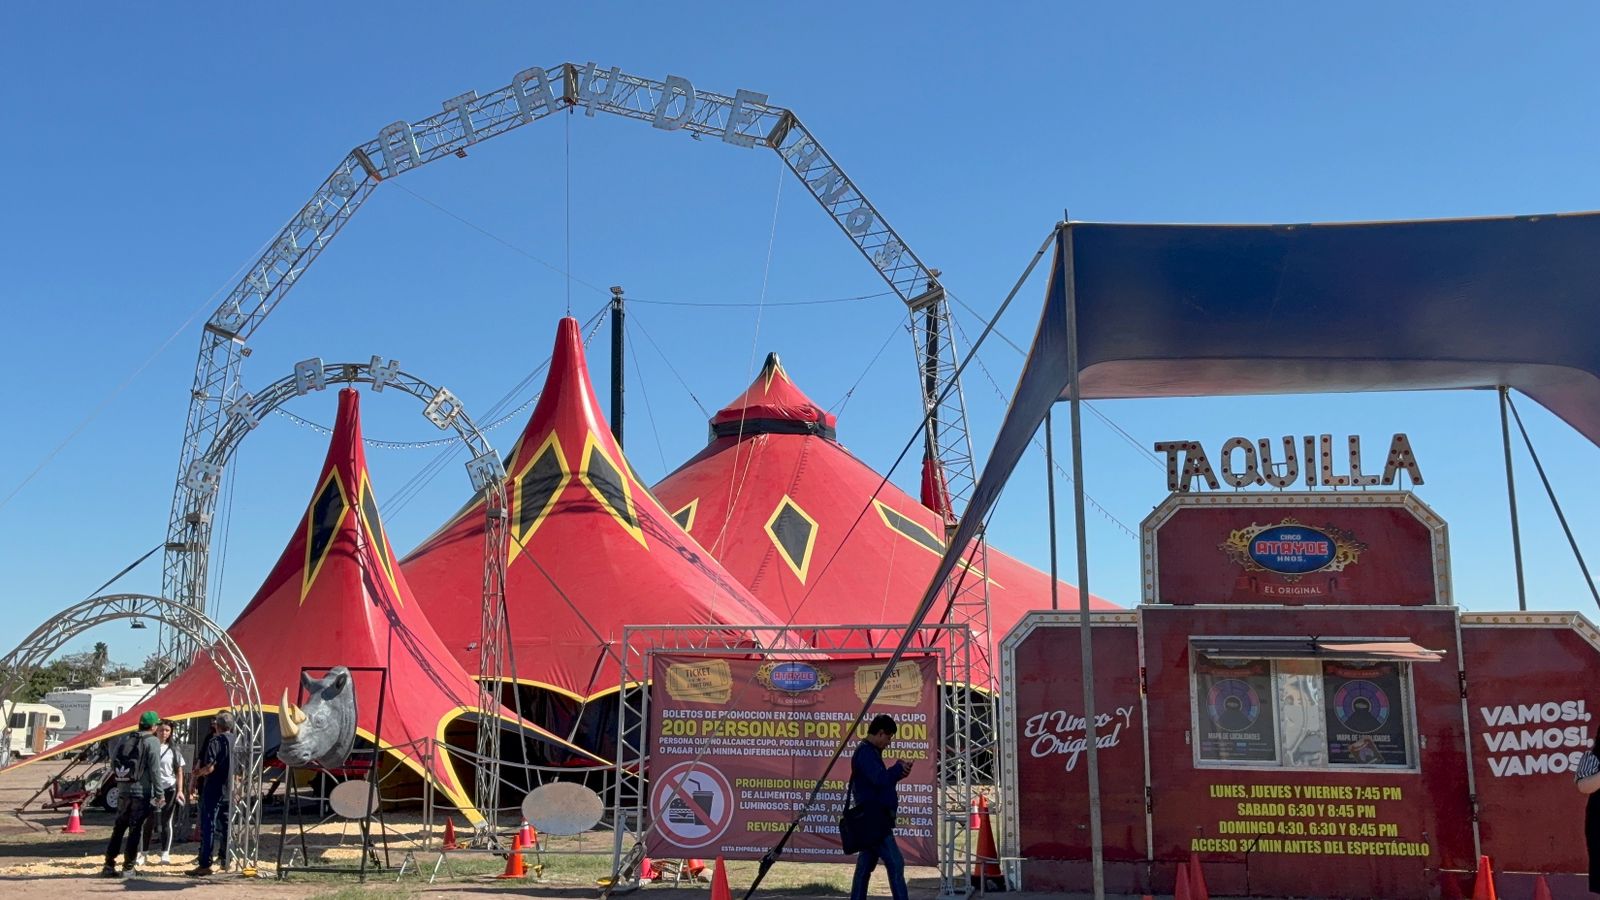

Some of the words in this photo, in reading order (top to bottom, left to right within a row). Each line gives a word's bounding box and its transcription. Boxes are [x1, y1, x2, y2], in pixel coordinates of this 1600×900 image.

[379, 62, 768, 177] ATAYDE
[1154, 433, 1424, 492] TAQUILLA
[1256, 541, 1329, 555] ATAYDE
[1264, 586, 1275, 594] EL
[1278, 586, 1322, 594] ORIGINAL
[662, 710, 703, 719] BOLETOS
[705, 711, 717, 719] DE
[719, 711, 772, 720] PROMOCION
[774, 712, 786, 720] EN
[788, 712, 812, 720] ZONA
[813, 712, 855, 721] GENERAL
[893, 713, 901, 722] A
[901, 713, 927, 722] CUPO
[1024, 712, 1049, 738] El
[1116, 706, 1134, 729] Y
[662, 720, 698, 736] 200
[702, 720, 800, 737] PERSONAS
[804, 722, 841, 738] POR
[659, 737, 694, 745] PERSONA
[722, 738, 755, 746] ALCANCE
[805, 740, 834, 748] ENTRAR
[897, 742, 929, 750] FUNCION
[660, 746, 666, 754] O
[667, 747, 693, 755] PAGAR
[712, 748, 742, 756] MINIMA
[743, 748, 790, 757] DIFERENCIA
[791, 749, 812, 757] PARA
[813, 749, 823, 757] LA
[735, 778, 791, 789] PROHIBIDO
[914, 784, 933, 793] TIPO
[1210, 784, 1248, 799] LUNES,
[1250, 785, 1292, 799] JUEVES
[1294, 786, 1302, 799] Y
[1303, 786, 1353, 799] VIERNES
[1355, 787, 1380, 800] 7:45
[1383, 787, 1401, 800] PM
[741, 790, 752, 799] DE
[753, 791, 804, 800] ALIMENTOS,
[805, 791, 841, 801] BBIDAS
[896, 806, 933, 815] OCHILAS
[1237, 803, 1285, 817] SABADO
[1288, 803, 1315, 817] 6:30
[1317, 804, 1325, 817] Y
[1327, 804, 1355, 818] 8:45
[1357, 805, 1376, 818] PM
[910, 817, 933, 826] SERA
[803, 825, 814, 833] AL
[1219, 821, 1275, 834] DOMINGO
[1277, 821, 1307, 836] 4:30,
[1309, 822, 1337, 836] 6:30
[1338, 823, 1347, 836] Y
[1349, 823, 1376, 837] 8:45
[1379, 824, 1398, 837] PM
[1191, 839, 1237, 852] ACCESO
[1258, 840, 1282, 853] MIN
[1284, 841, 1322, 854] ANTES
[1324, 841, 1345, 854] DEL
[1347, 840, 1430, 856] ESPECTÁCULO
